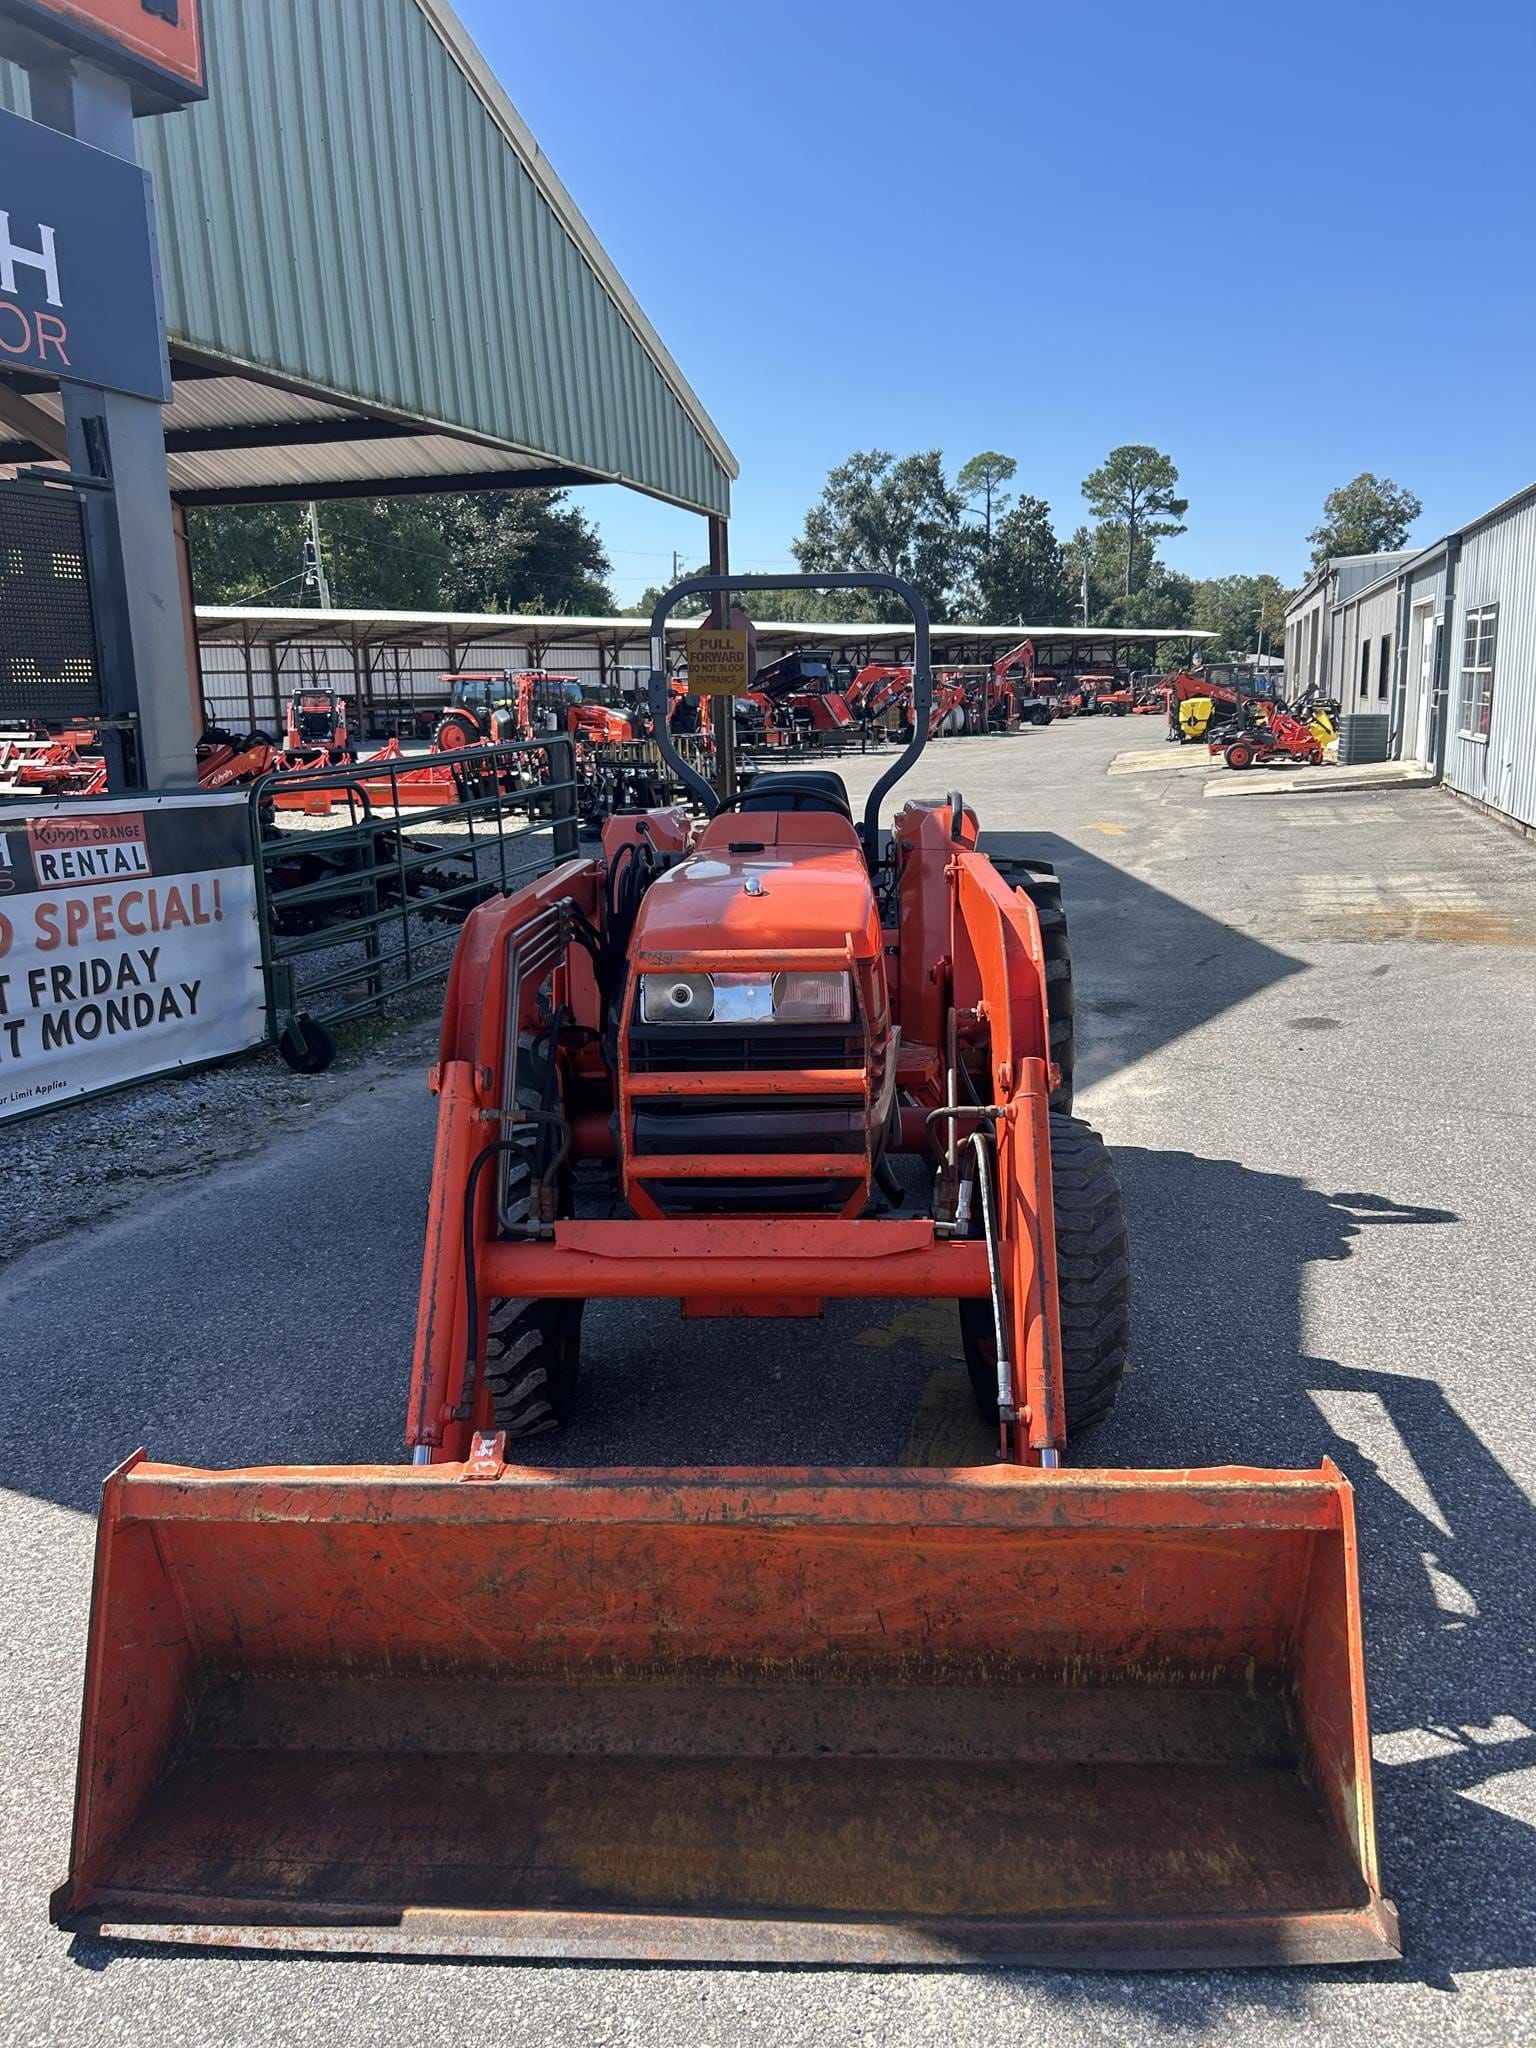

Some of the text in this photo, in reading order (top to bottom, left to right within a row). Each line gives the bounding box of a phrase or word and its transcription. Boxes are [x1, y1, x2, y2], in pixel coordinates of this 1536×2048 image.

[700, 638, 734, 650] PULL
[690, 651, 745, 663] FORWARD
[689, 663, 745, 673] DO NOT BLOCK
[696, 675, 736, 684] ENTRANCE
[33, 824, 139, 844] Kubota ORANGE
[40, 845, 146, 881] RENTAL
[35, 879, 224, 951] SPECIAL!
[28, 947, 160, 1008] FRIDAY
[41, 980, 201, 1050] MONDAY
[11, 1089, 32, 1101] Limit
[35, 1080, 67, 1095] Applies
